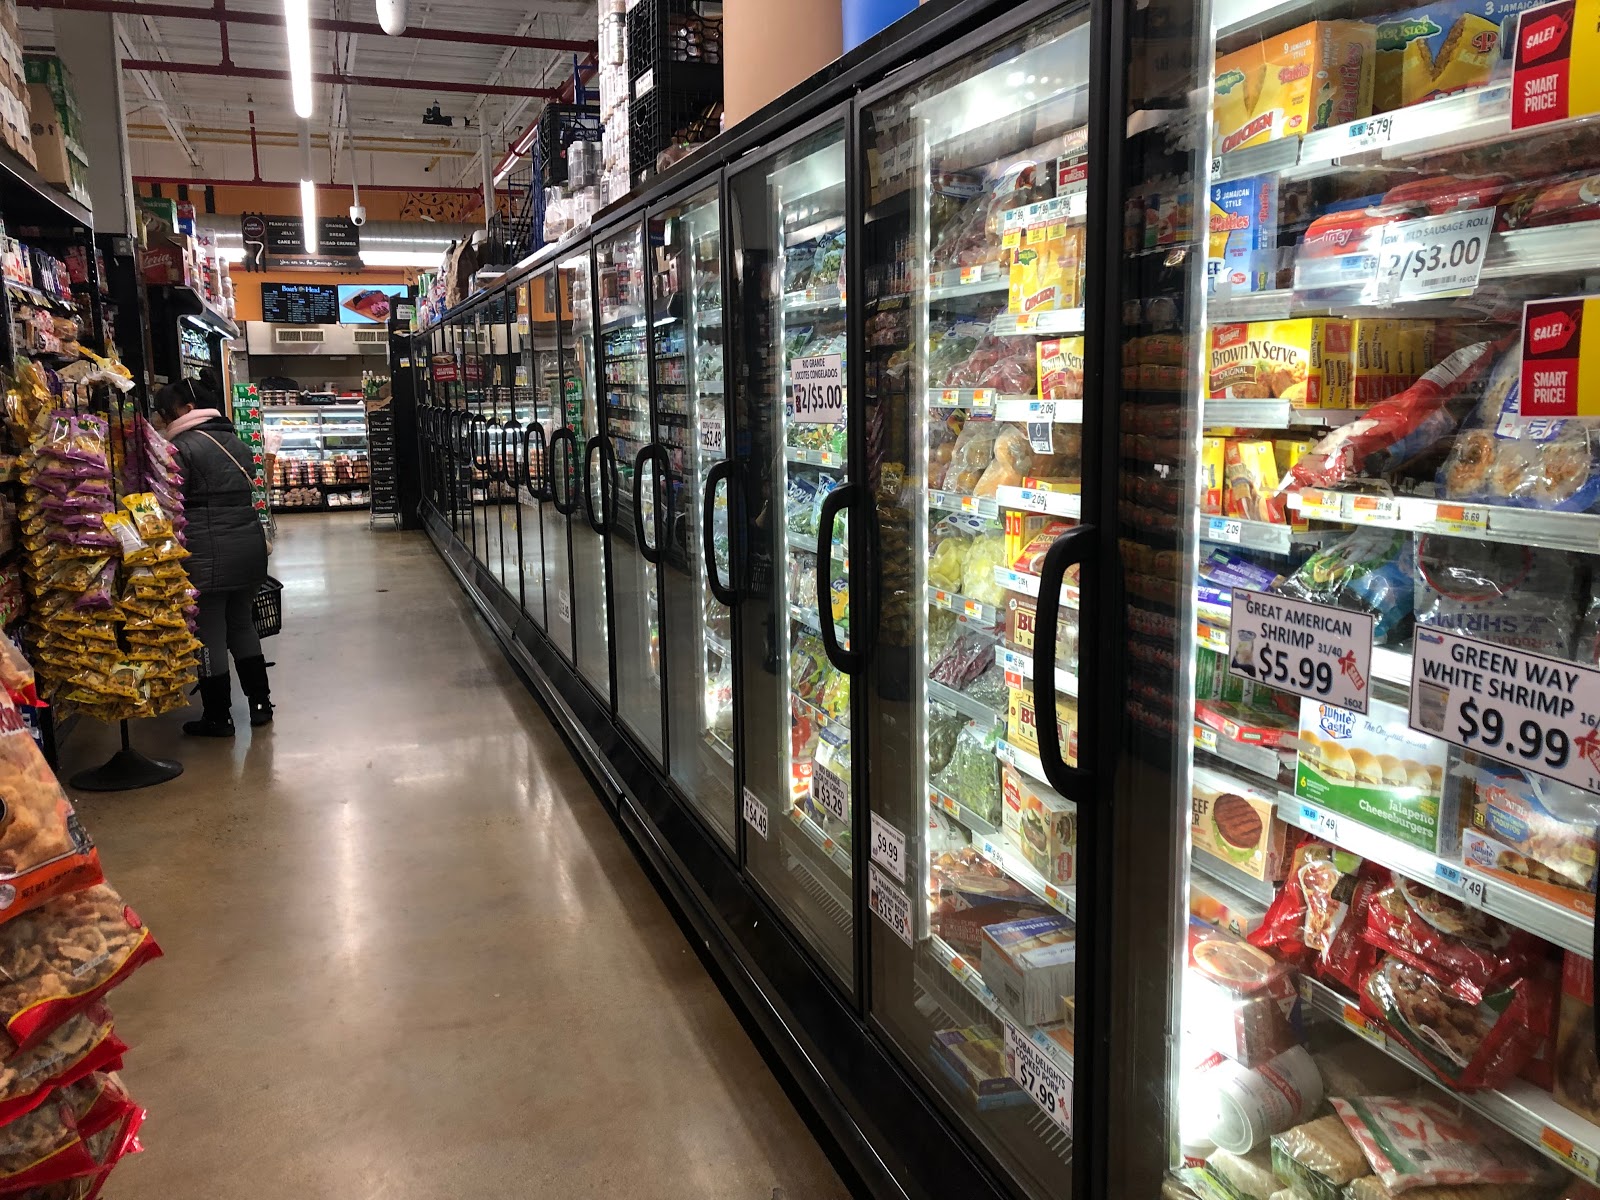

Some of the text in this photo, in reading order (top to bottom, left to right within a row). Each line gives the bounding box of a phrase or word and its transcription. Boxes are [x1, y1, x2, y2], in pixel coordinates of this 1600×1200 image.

[1485, 2, 1495, 15] 3
[1526, 26, 1555, 49] SALE!
[1524, 74, 1558, 96] SMART
[1525, 91, 1557, 113] PRICE!
[1222, 111, 1274, 154] CHICKEN
[1215, 188, 1250, 201] 3 JAMAICAN
[1225, 198, 1243, 209] STYLE
[1424, 222, 1464, 238] SAUSAGE
[1466, 216, 1490, 229] ROLL
[1388, 237, 1481, 282] 2/$3.00
[1534, 323, 1563, 341] SALE!
[1262, 340, 1297, 365] Serve
[1219, 366, 1247, 380] ORIGINAL
[1534, 371, 1568, 388] SMART
[802, 383, 842, 414] 2/$5.00
[1534, 388, 1566, 404] PRICE!
[1246, 600, 1283, 621] GREAT
[1285, 609, 1352, 637] AMERICAN
[1260, 622, 1314, 651] SHRIMP
[1318, 642, 1342, 658] 31/40
[1259, 642, 1334, 696] $5.99
[1451, 643, 1579, 695] GREEN WAY
[1422, 657, 1575, 719] WHITE SHRIMP
[1320, 717, 1352, 737] Castle
[1323, 705, 1352, 725] White
[1458, 696, 1571, 769] $9.99
[1300, 776, 1307, 787] 6
[821, 784, 843, 817] $3.29
[1389, 799, 1435, 826] Jalapeño
[749, 803, 767, 835] $4.49
[1359, 799, 1434, 839] Cheeseburgers
[1493, 814, 1521, 836] TAQUITOS
[877, 832, 898, 862] $9.99
[879, 900, 904, 935] $15.99
[1010, 1031, 1066, 1090] GLOBAL DELIGHTS
[1016, 1046, 1060, 1096] COOKED PORK
[1020, 1063, 1056, 1113] $7.99
